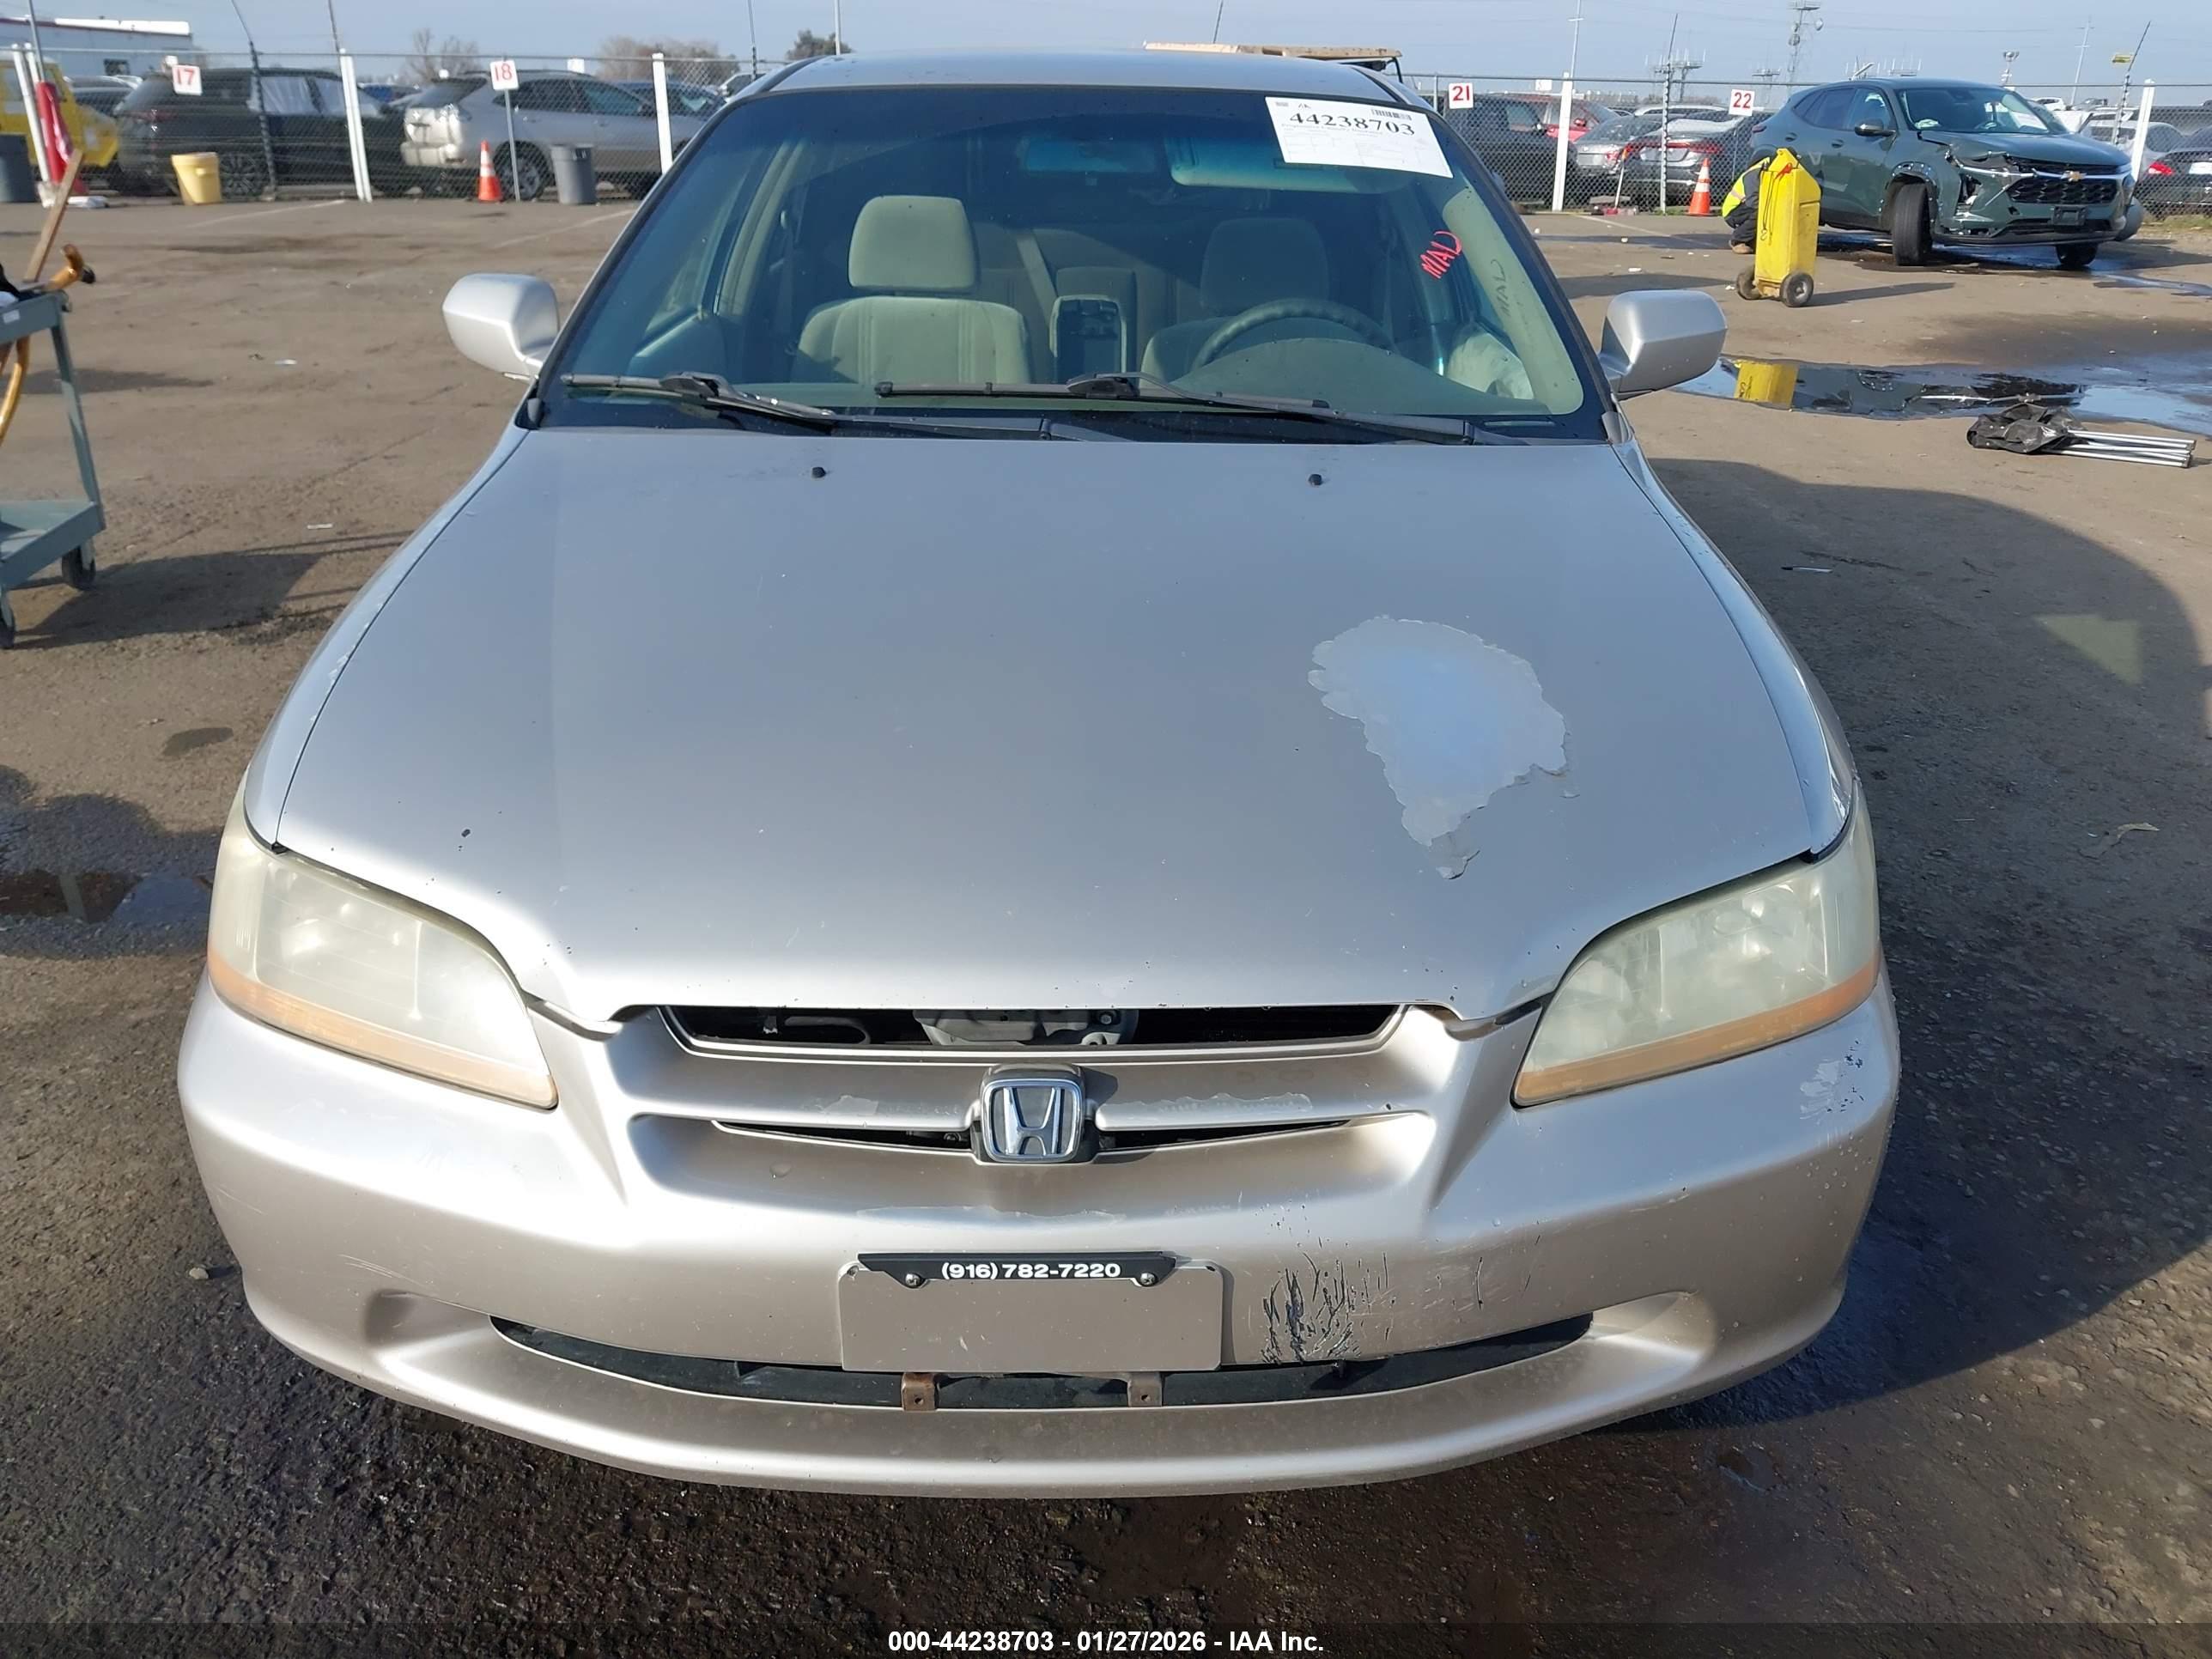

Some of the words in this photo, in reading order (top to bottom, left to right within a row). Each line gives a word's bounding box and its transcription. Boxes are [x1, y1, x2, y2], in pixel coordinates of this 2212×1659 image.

[177, 68, 195, 85] 17
[495, 63, 513, 82] 18
[1452, 85, 1471, 101] 21
[1733, 92, 1752, 109] 22
[1290, 112, 1415, 136] 44238703
[941, 1262, 999, 1280] (916)
[1002, 1263, 1121, 1278] 782-7220
